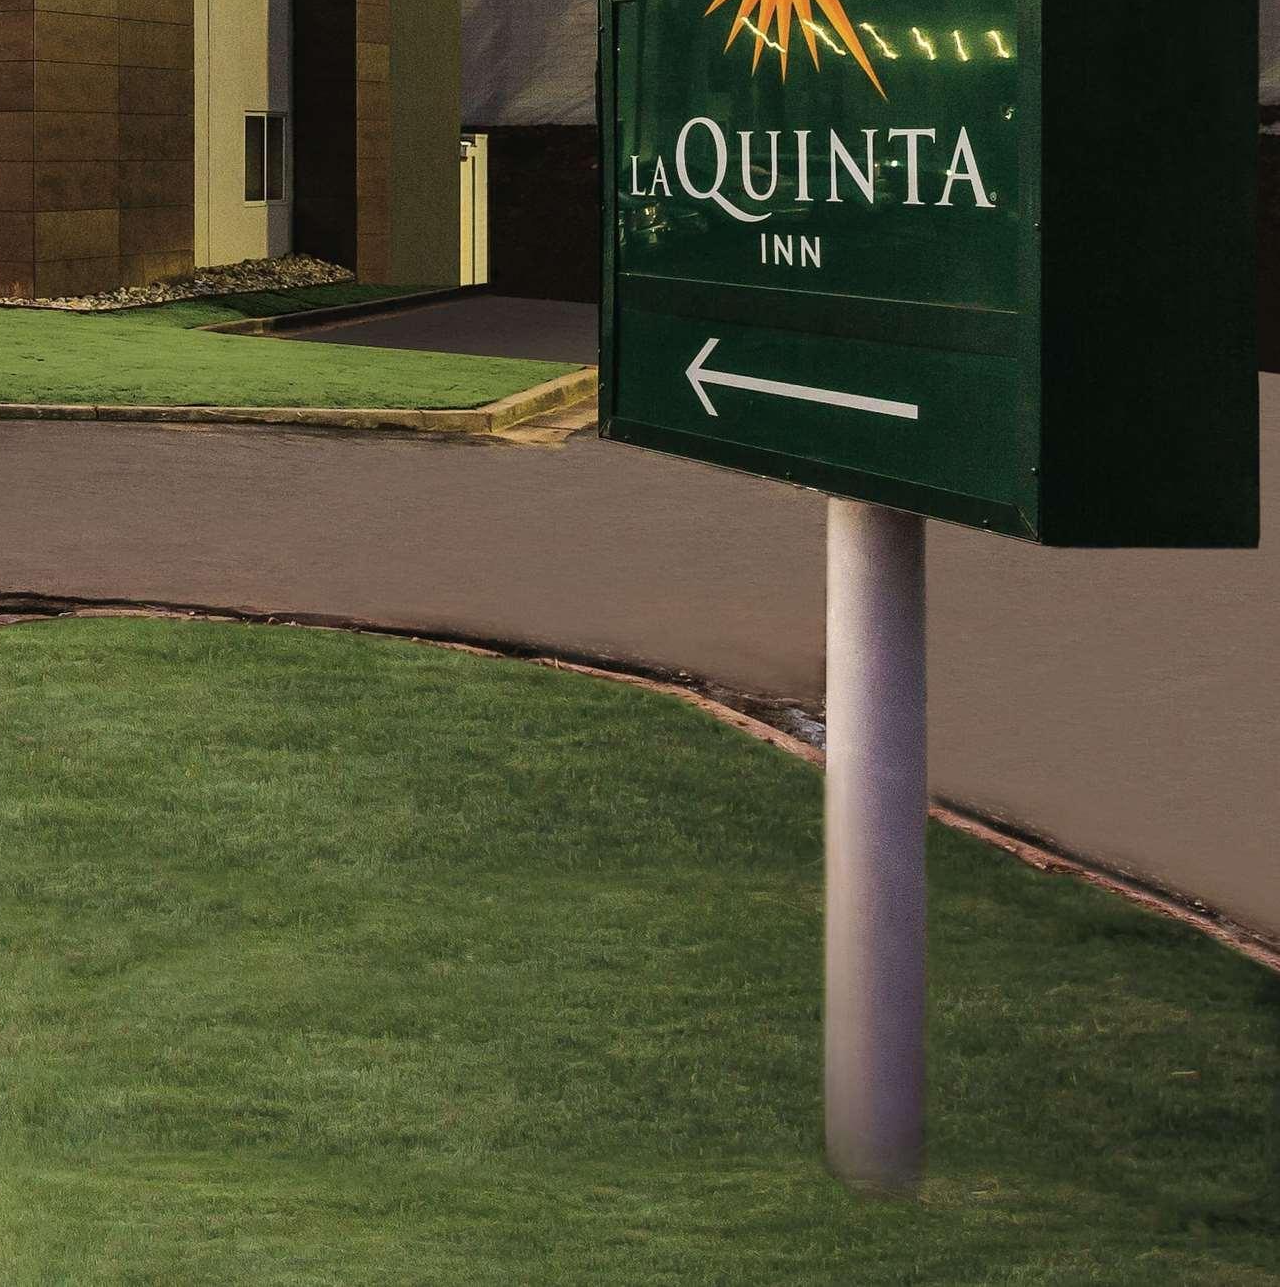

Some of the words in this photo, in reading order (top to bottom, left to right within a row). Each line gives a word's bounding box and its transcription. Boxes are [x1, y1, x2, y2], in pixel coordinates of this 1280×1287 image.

[630, 155, 673, 197] LA
[675, 116, 996, 223] QUINTA
[759, 233, 821, 268] INN
